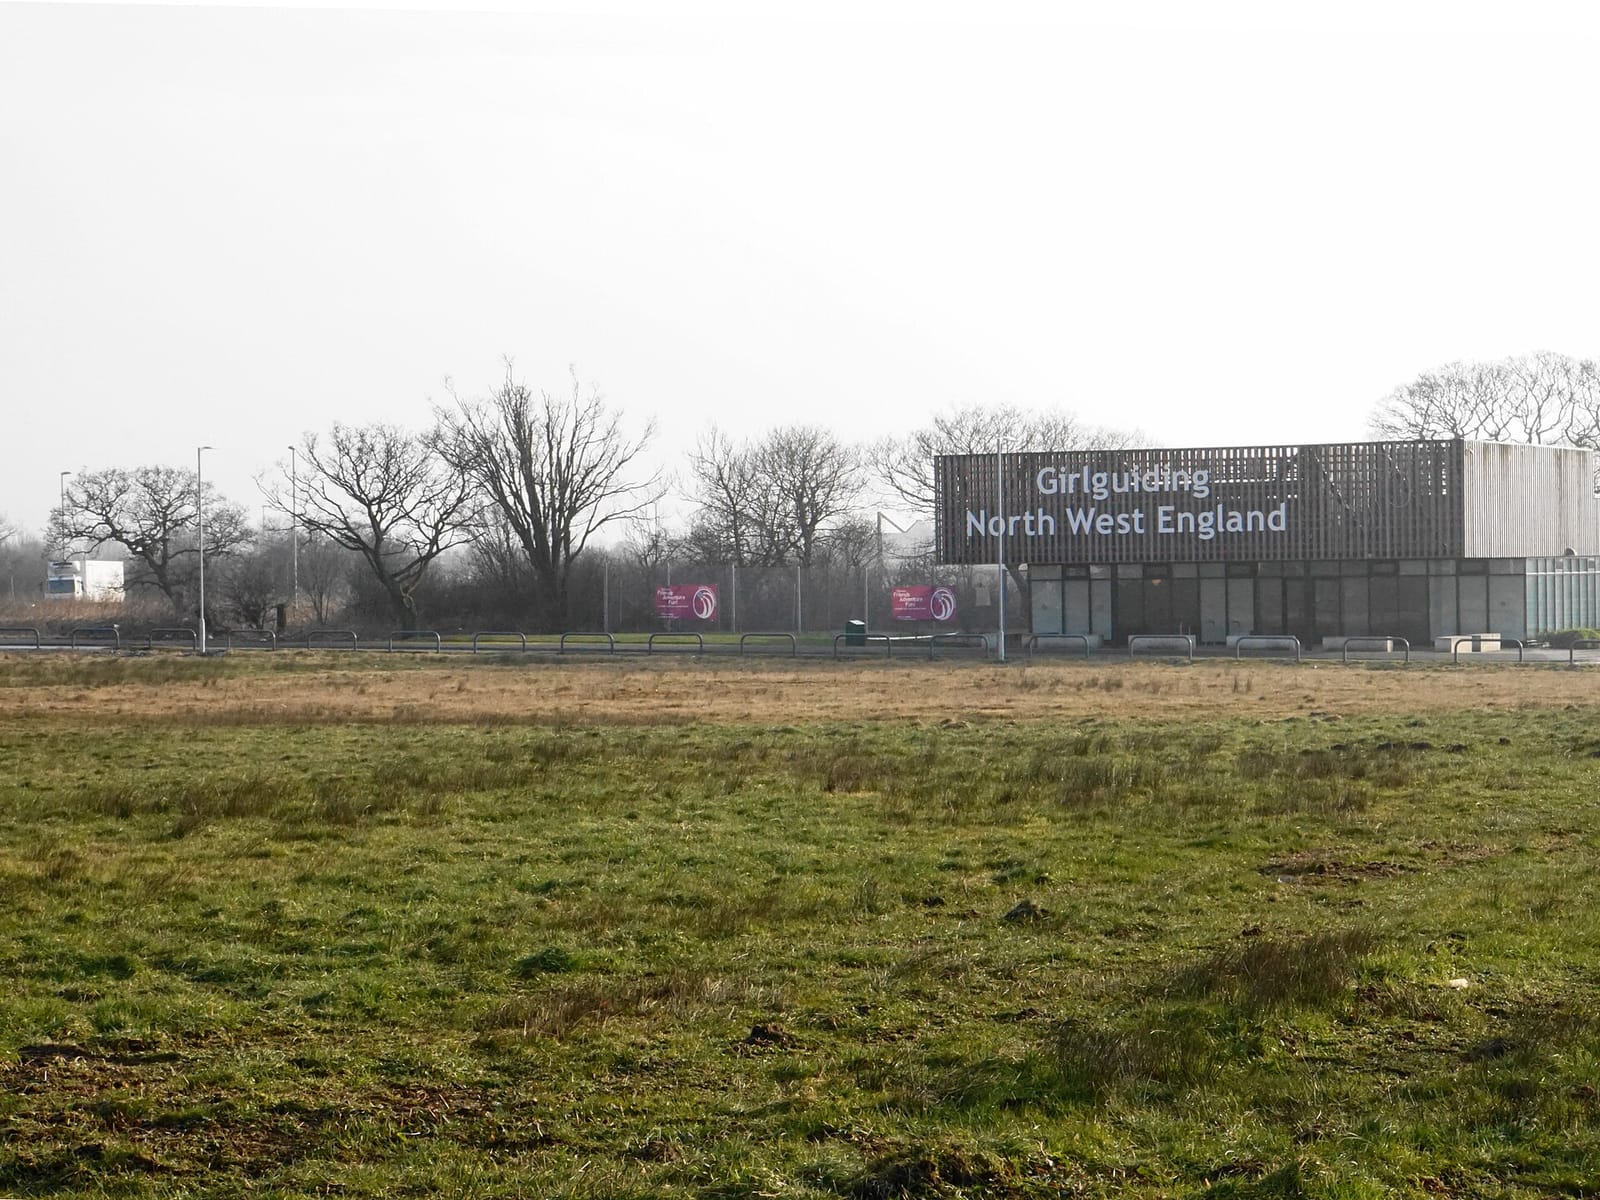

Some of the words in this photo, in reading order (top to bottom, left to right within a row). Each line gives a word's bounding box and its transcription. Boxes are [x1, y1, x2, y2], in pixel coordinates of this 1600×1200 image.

[1036, 463, 1211, 500] Girlguiding
[966, 507, 1055, 537] North
[1065, 507, 1145, 535] West
[1157, 502, 1287, 540] England
